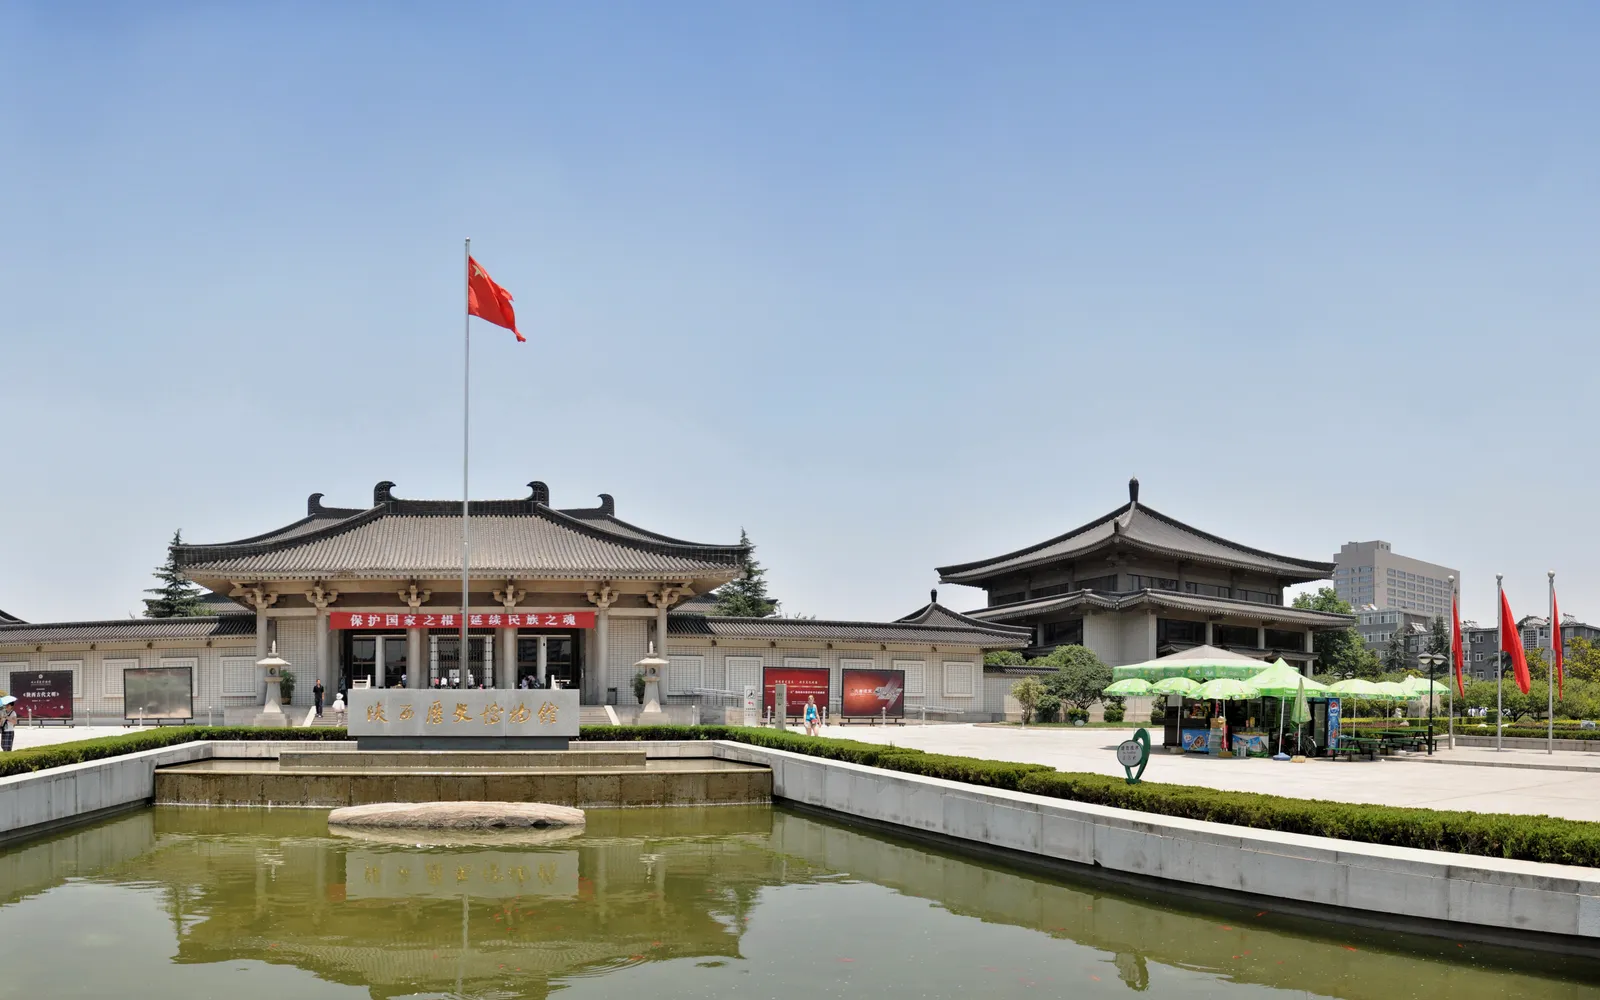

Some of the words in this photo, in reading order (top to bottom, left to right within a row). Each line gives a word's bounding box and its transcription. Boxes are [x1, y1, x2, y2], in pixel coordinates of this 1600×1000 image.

[350, 614, 455, 627] 保护国家之根
[470, 614, 576, 626] 延续民族之魂
